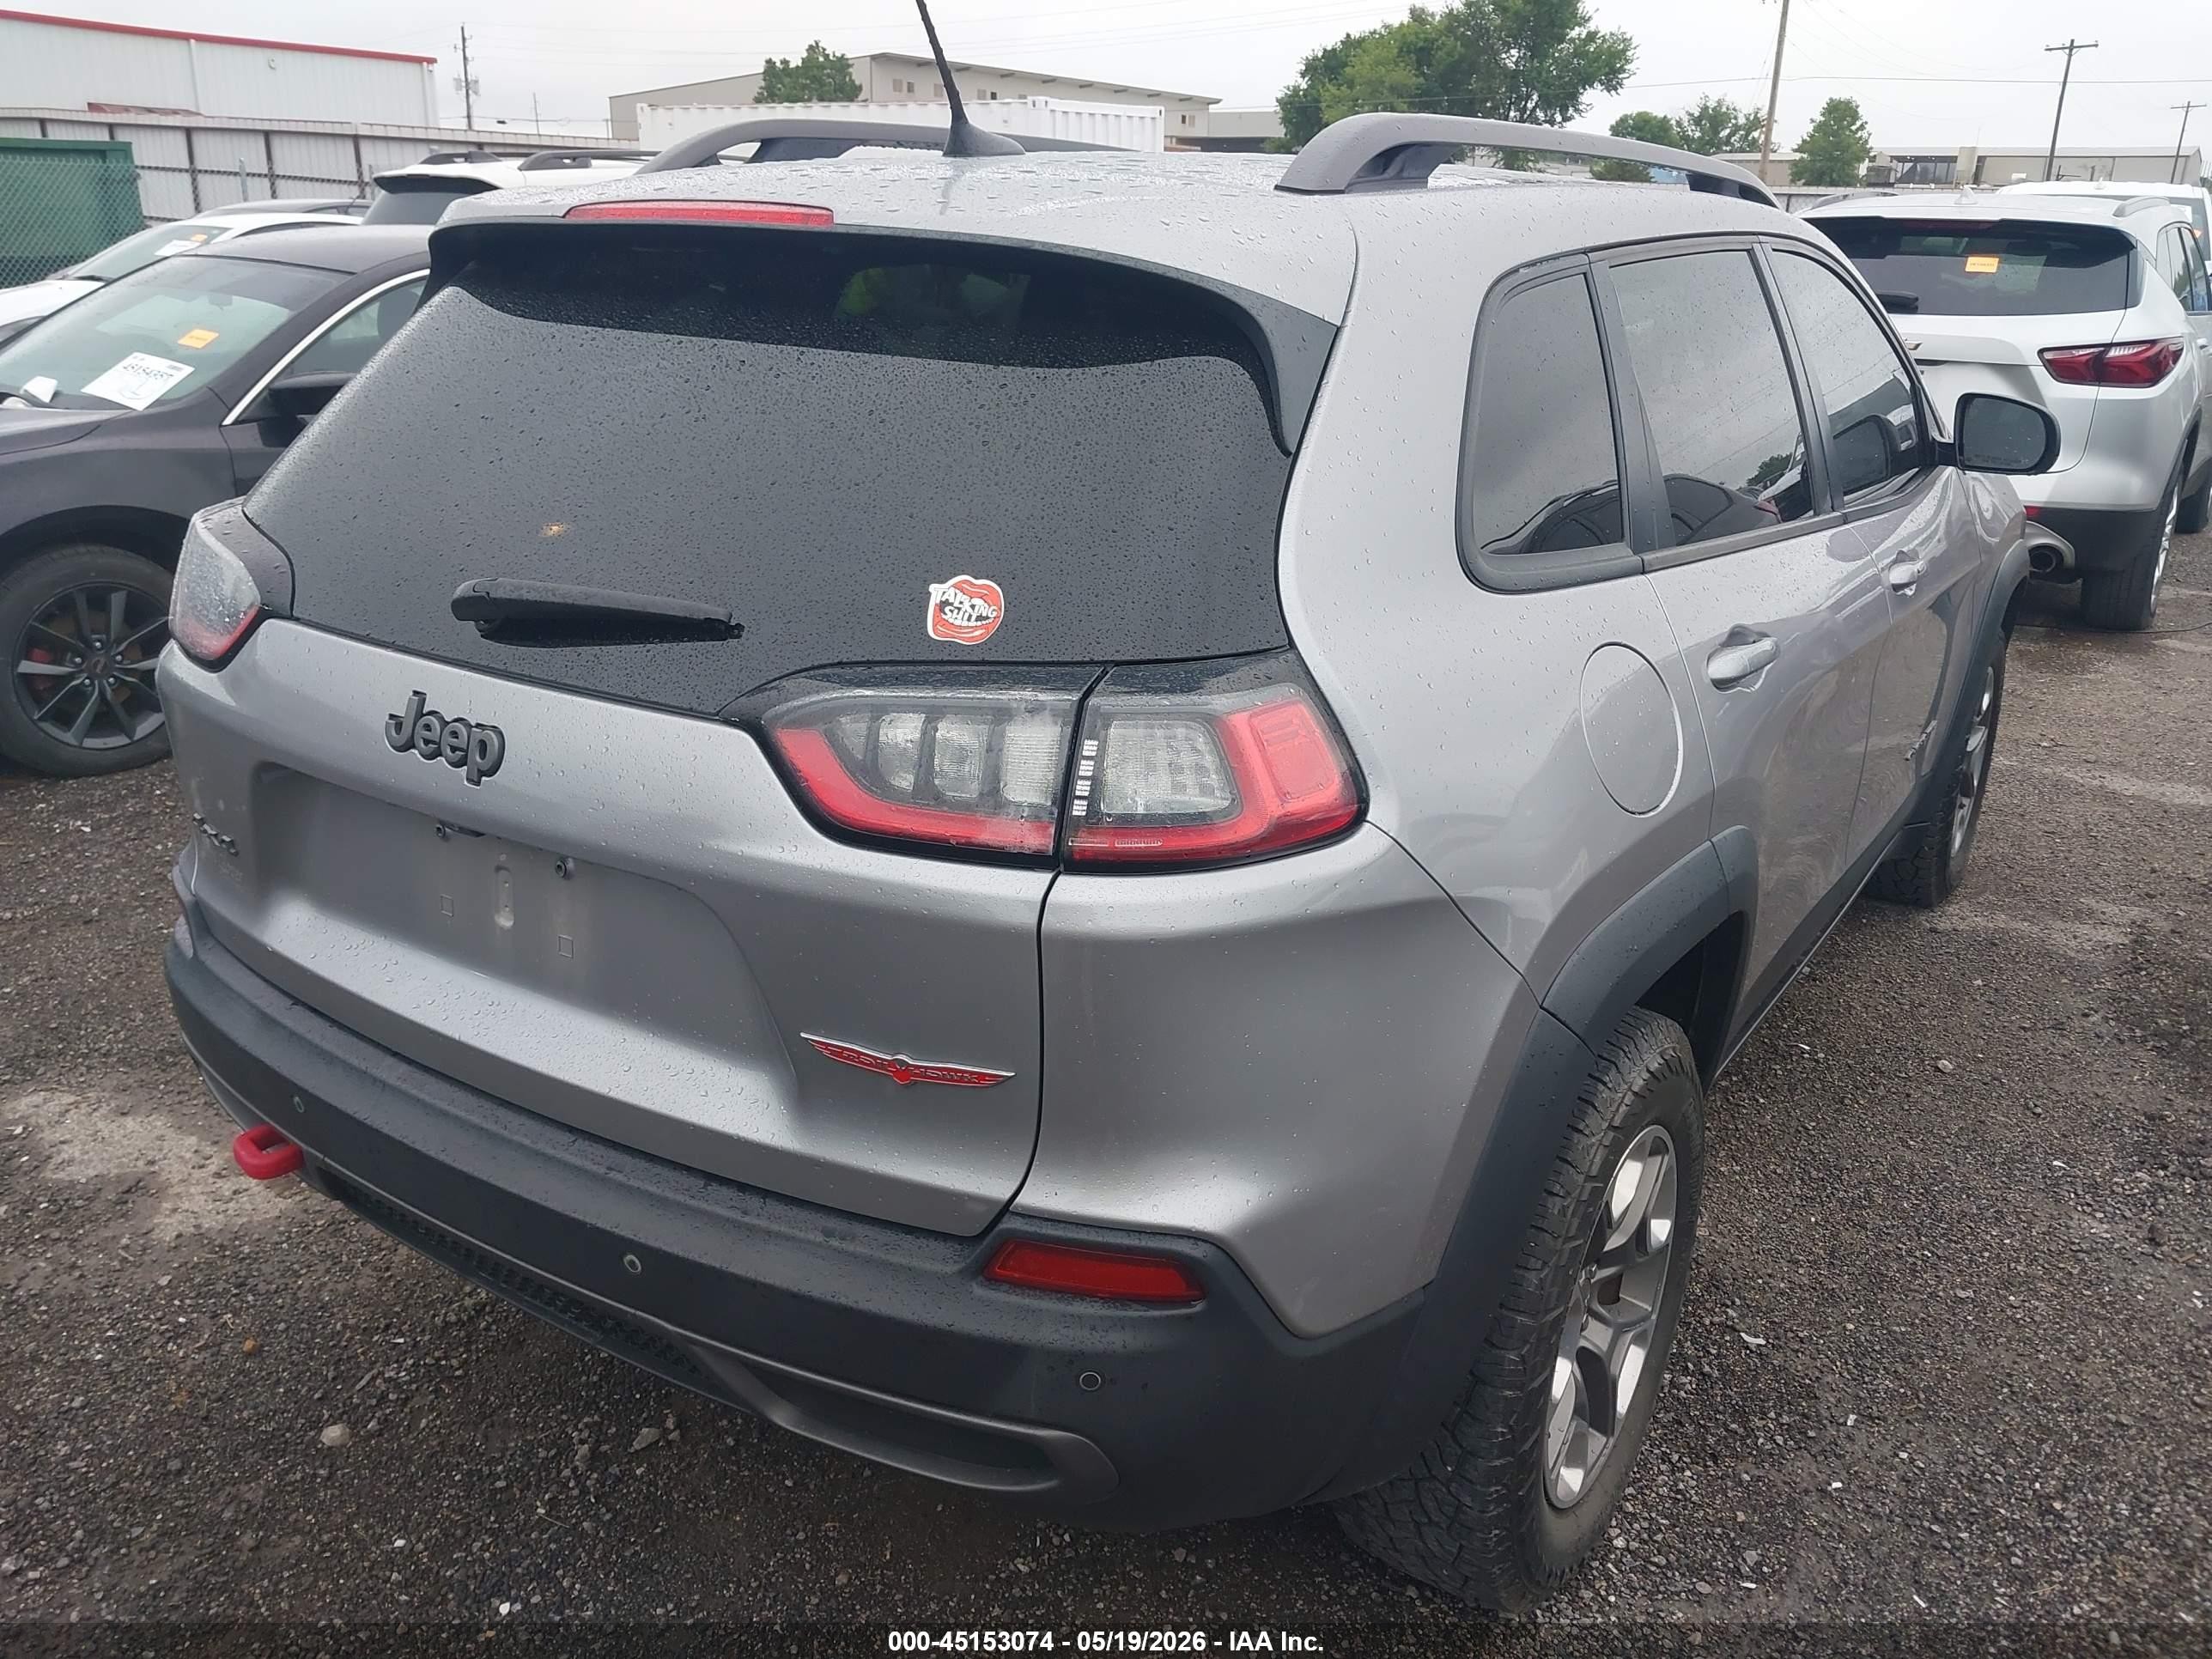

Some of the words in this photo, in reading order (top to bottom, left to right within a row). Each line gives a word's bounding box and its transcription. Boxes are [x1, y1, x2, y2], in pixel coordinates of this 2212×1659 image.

[933, 586, 998, 617] TALKING
[944, 605, 978, 623] SHIT
[385, 690, 505, 787] Jeep
